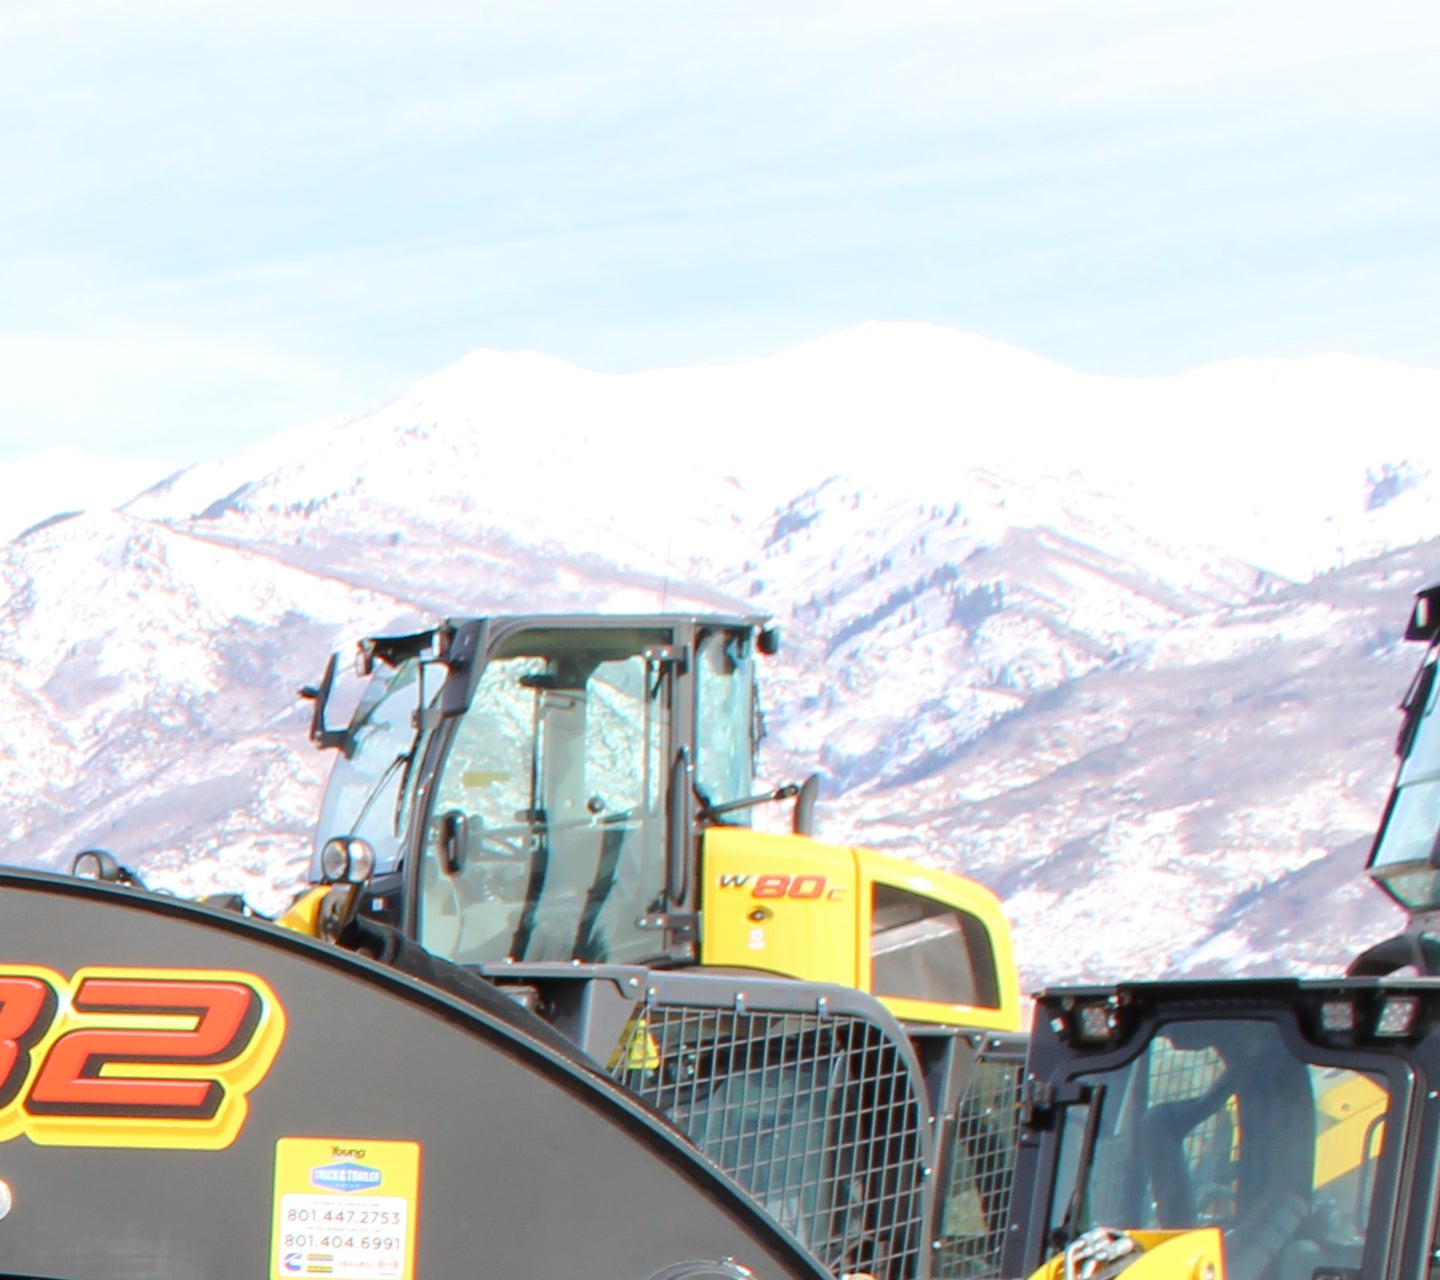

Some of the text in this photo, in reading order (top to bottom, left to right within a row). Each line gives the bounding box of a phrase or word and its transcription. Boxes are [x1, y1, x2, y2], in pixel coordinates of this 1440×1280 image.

[331, 1146, 366, 1159] Young
[287, 1209, 400, 1225] 801.447.2753
[284, 1234, 400, 1250] 801.404.6991
